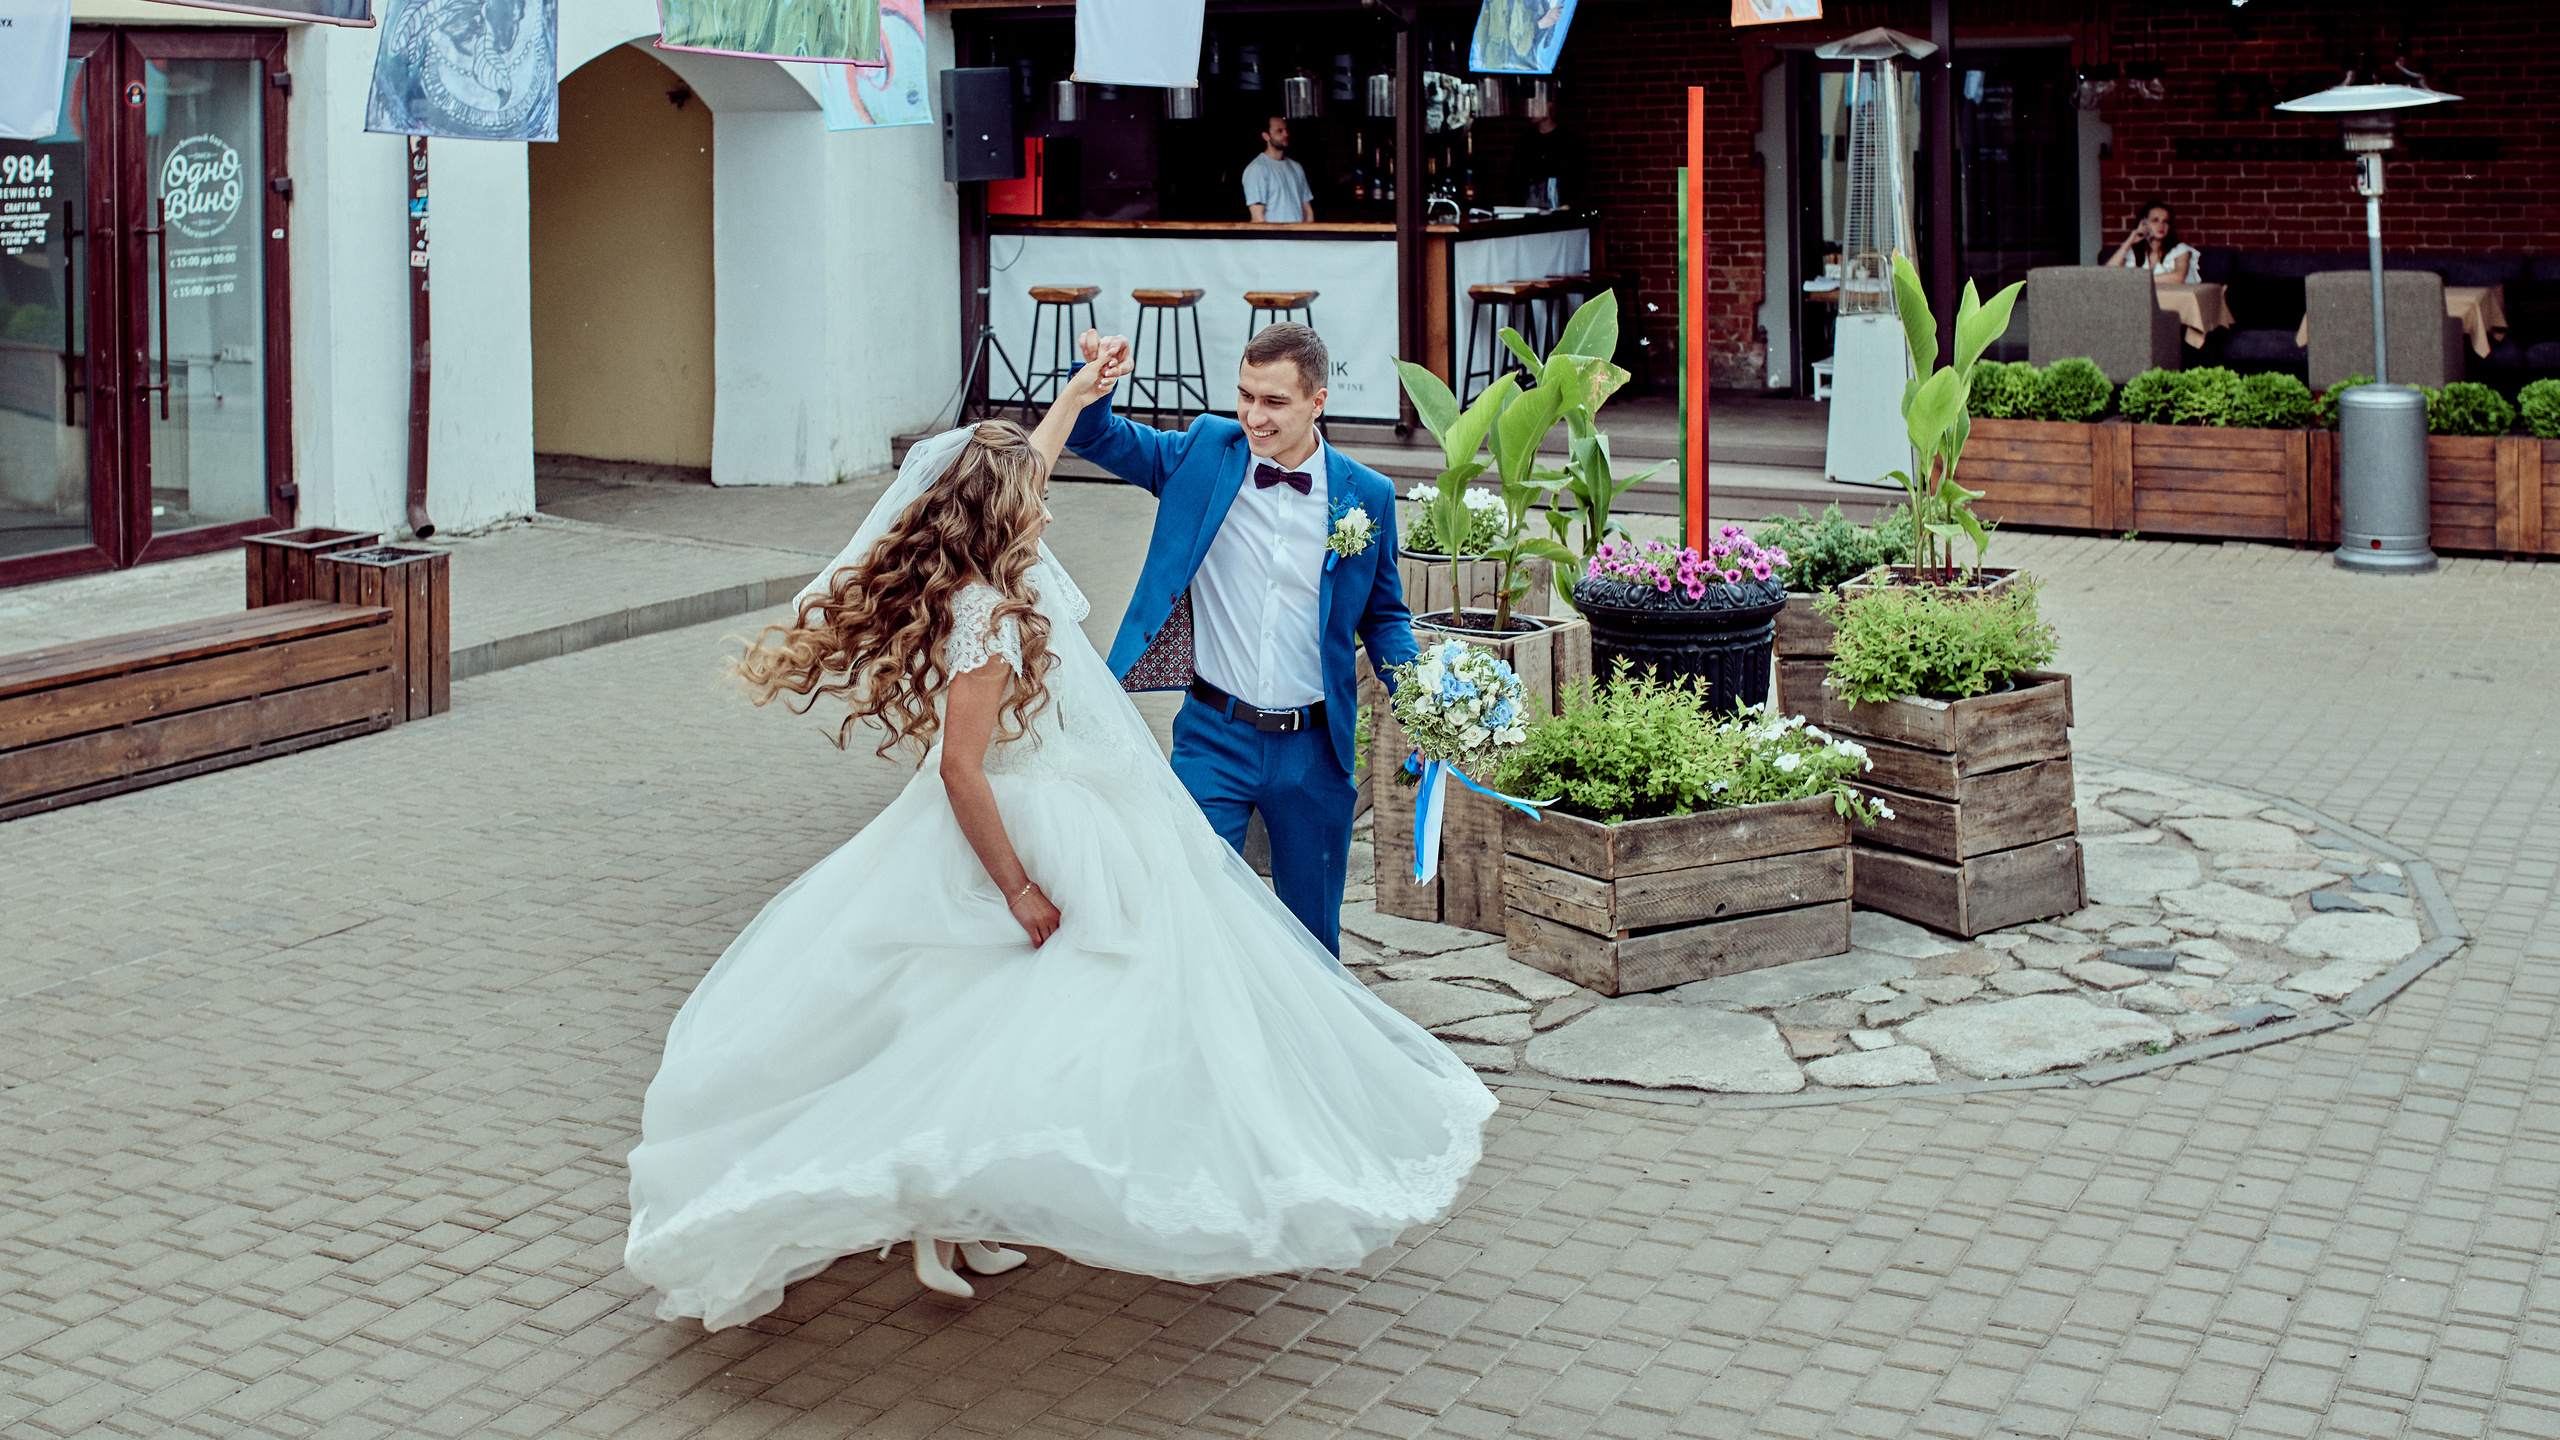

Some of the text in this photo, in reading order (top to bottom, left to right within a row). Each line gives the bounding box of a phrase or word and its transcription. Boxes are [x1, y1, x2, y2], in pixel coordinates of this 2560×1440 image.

[0, 154, 54, 185] 984
[38, 185, 53, 199] CO
[4, 201, 41, 214] CRAFT BAR
[177, 255, 200, 268] 15:00
[200, 256, 212, 268] до
[213, 252, 237, 265] 00:00
[180, 284, 203, 298] 15:00
[203, 285, 216, 297] до
[1337, 383, 1364, 391] WINE
